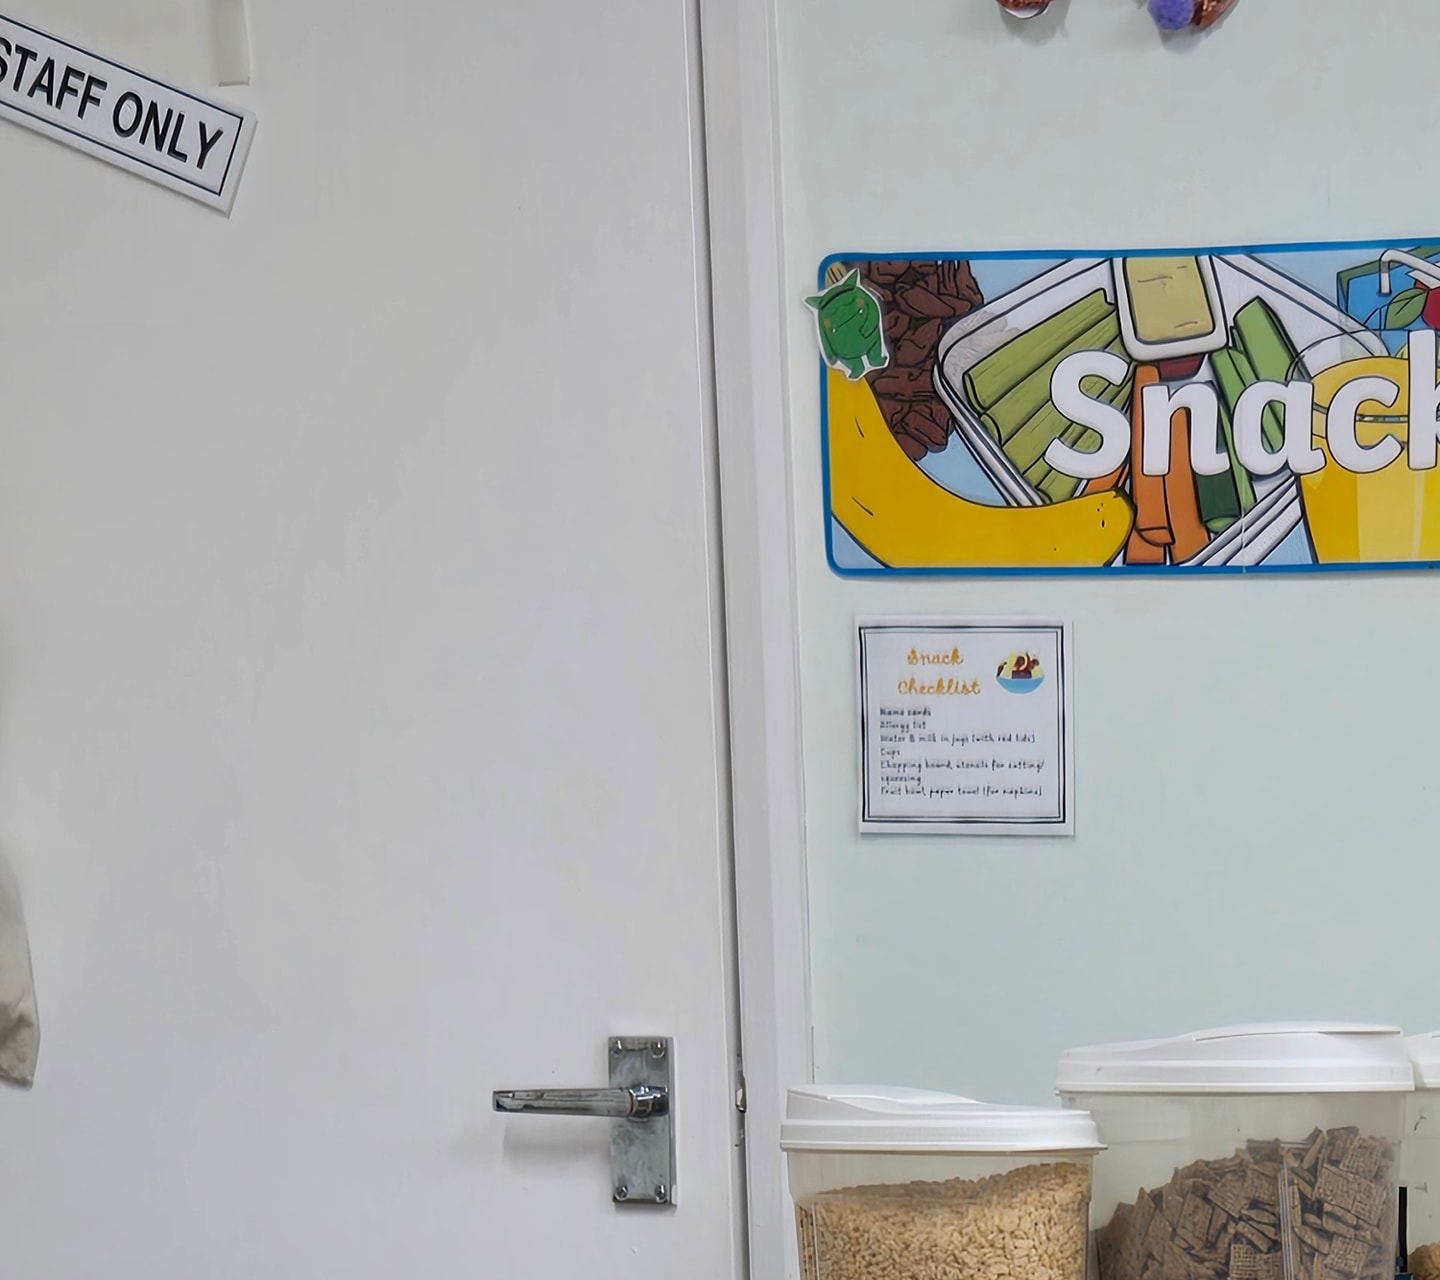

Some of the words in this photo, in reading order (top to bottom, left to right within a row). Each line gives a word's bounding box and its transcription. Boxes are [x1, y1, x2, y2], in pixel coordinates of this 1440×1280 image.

[0, 36, 108, 120] STAFF
[112, 91, 224, 170] ONLY
[907, 646, 964, 666] Snack
[897, 677, 981, 696] Checklist
